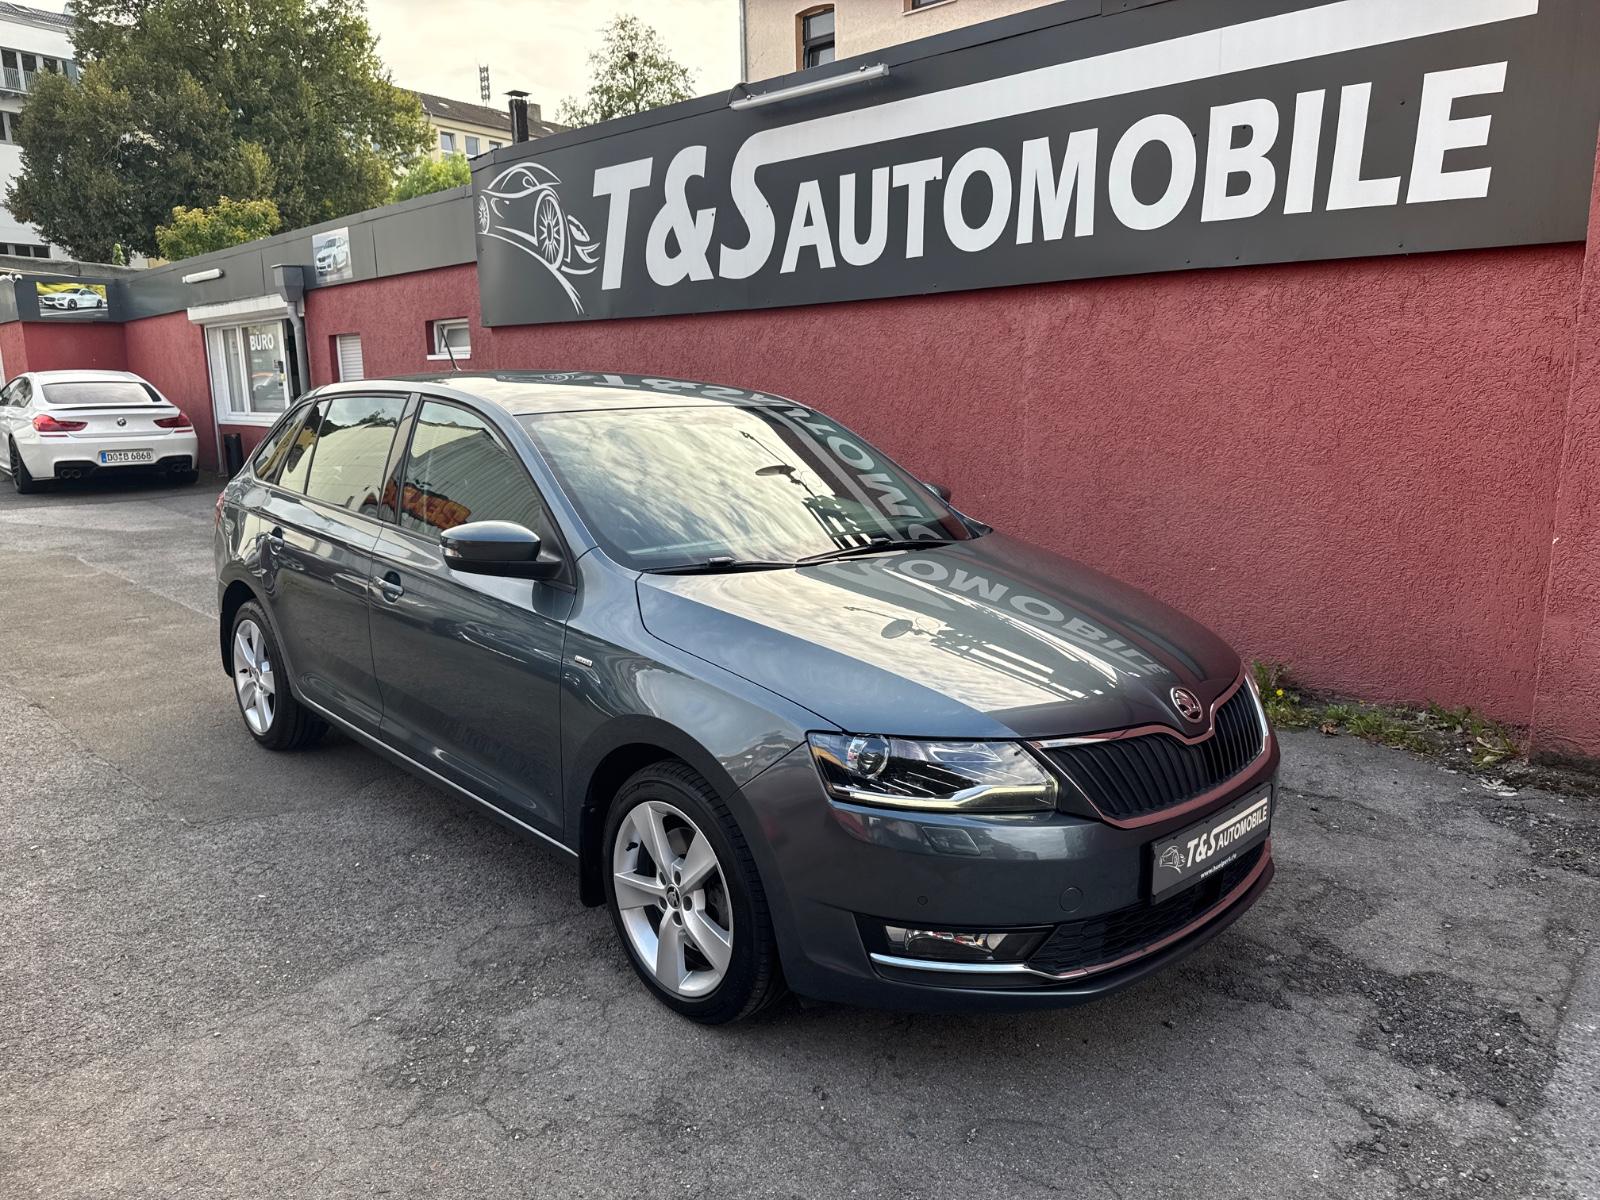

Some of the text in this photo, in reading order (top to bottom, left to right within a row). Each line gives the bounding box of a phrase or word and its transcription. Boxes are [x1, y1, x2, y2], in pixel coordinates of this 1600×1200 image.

[593, 61, 1508, 290] T&S AUTOMOBILE
[249, 332, 274, 351] BÜRO
[1187, 829, 1216, 867] T&S
[1217, 805, 1267, 850] AUTOMOBILE
